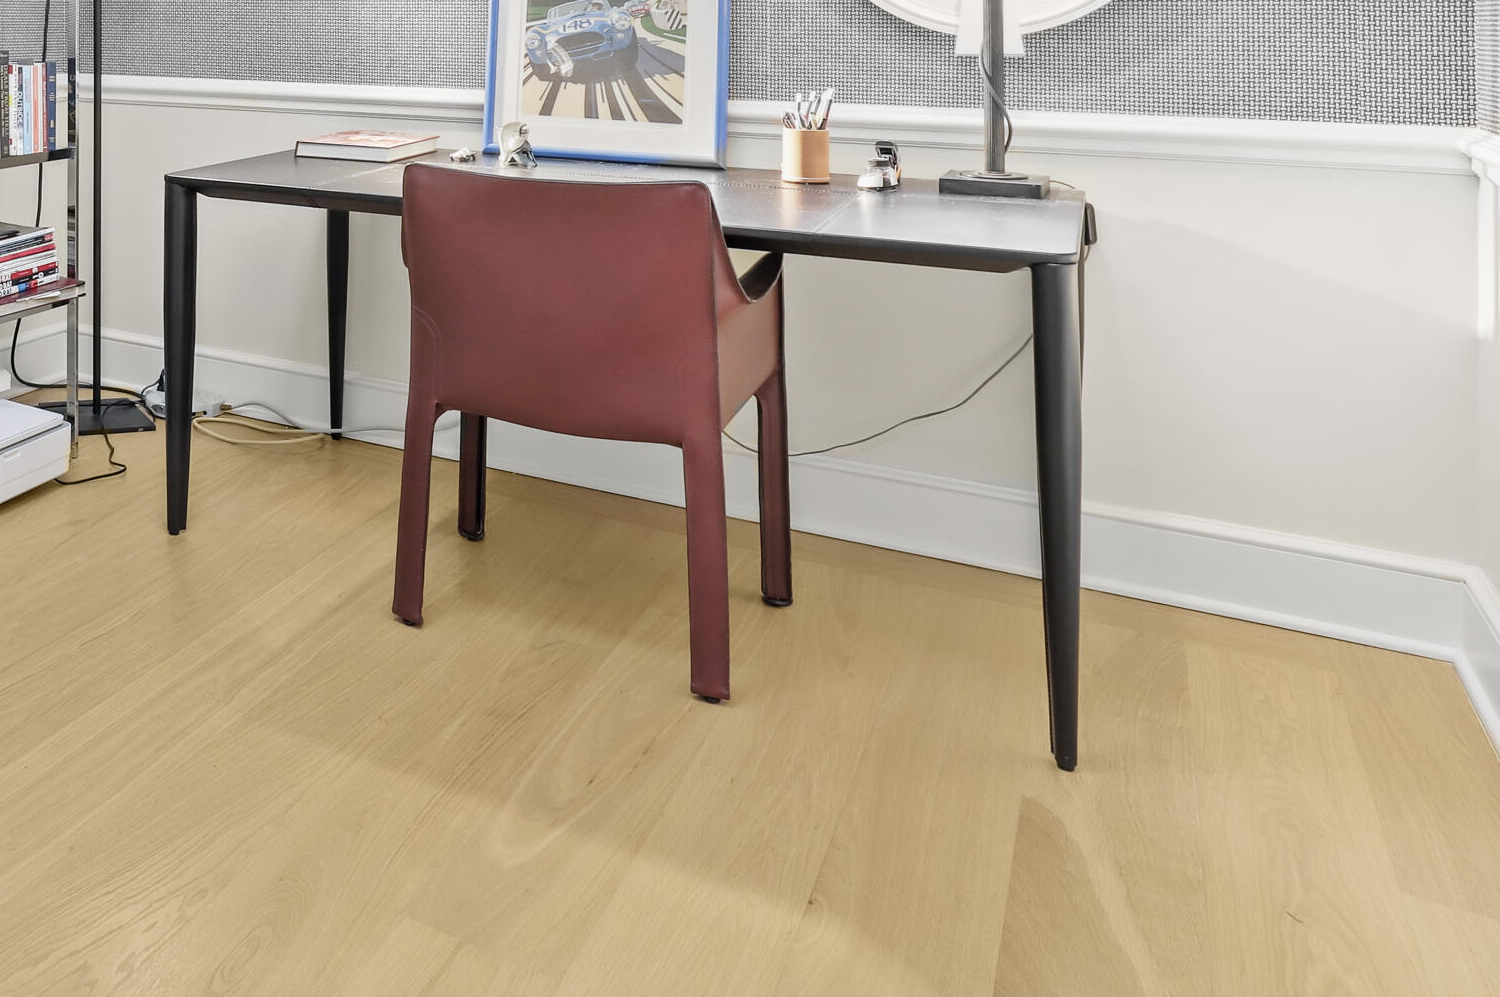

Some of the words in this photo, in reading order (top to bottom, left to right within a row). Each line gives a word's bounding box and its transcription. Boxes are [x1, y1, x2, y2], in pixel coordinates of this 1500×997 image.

[561, 16, 593, 33] 148
[2, 273, 12, 282] RAT
[3, 281, 13, 290] RAT
